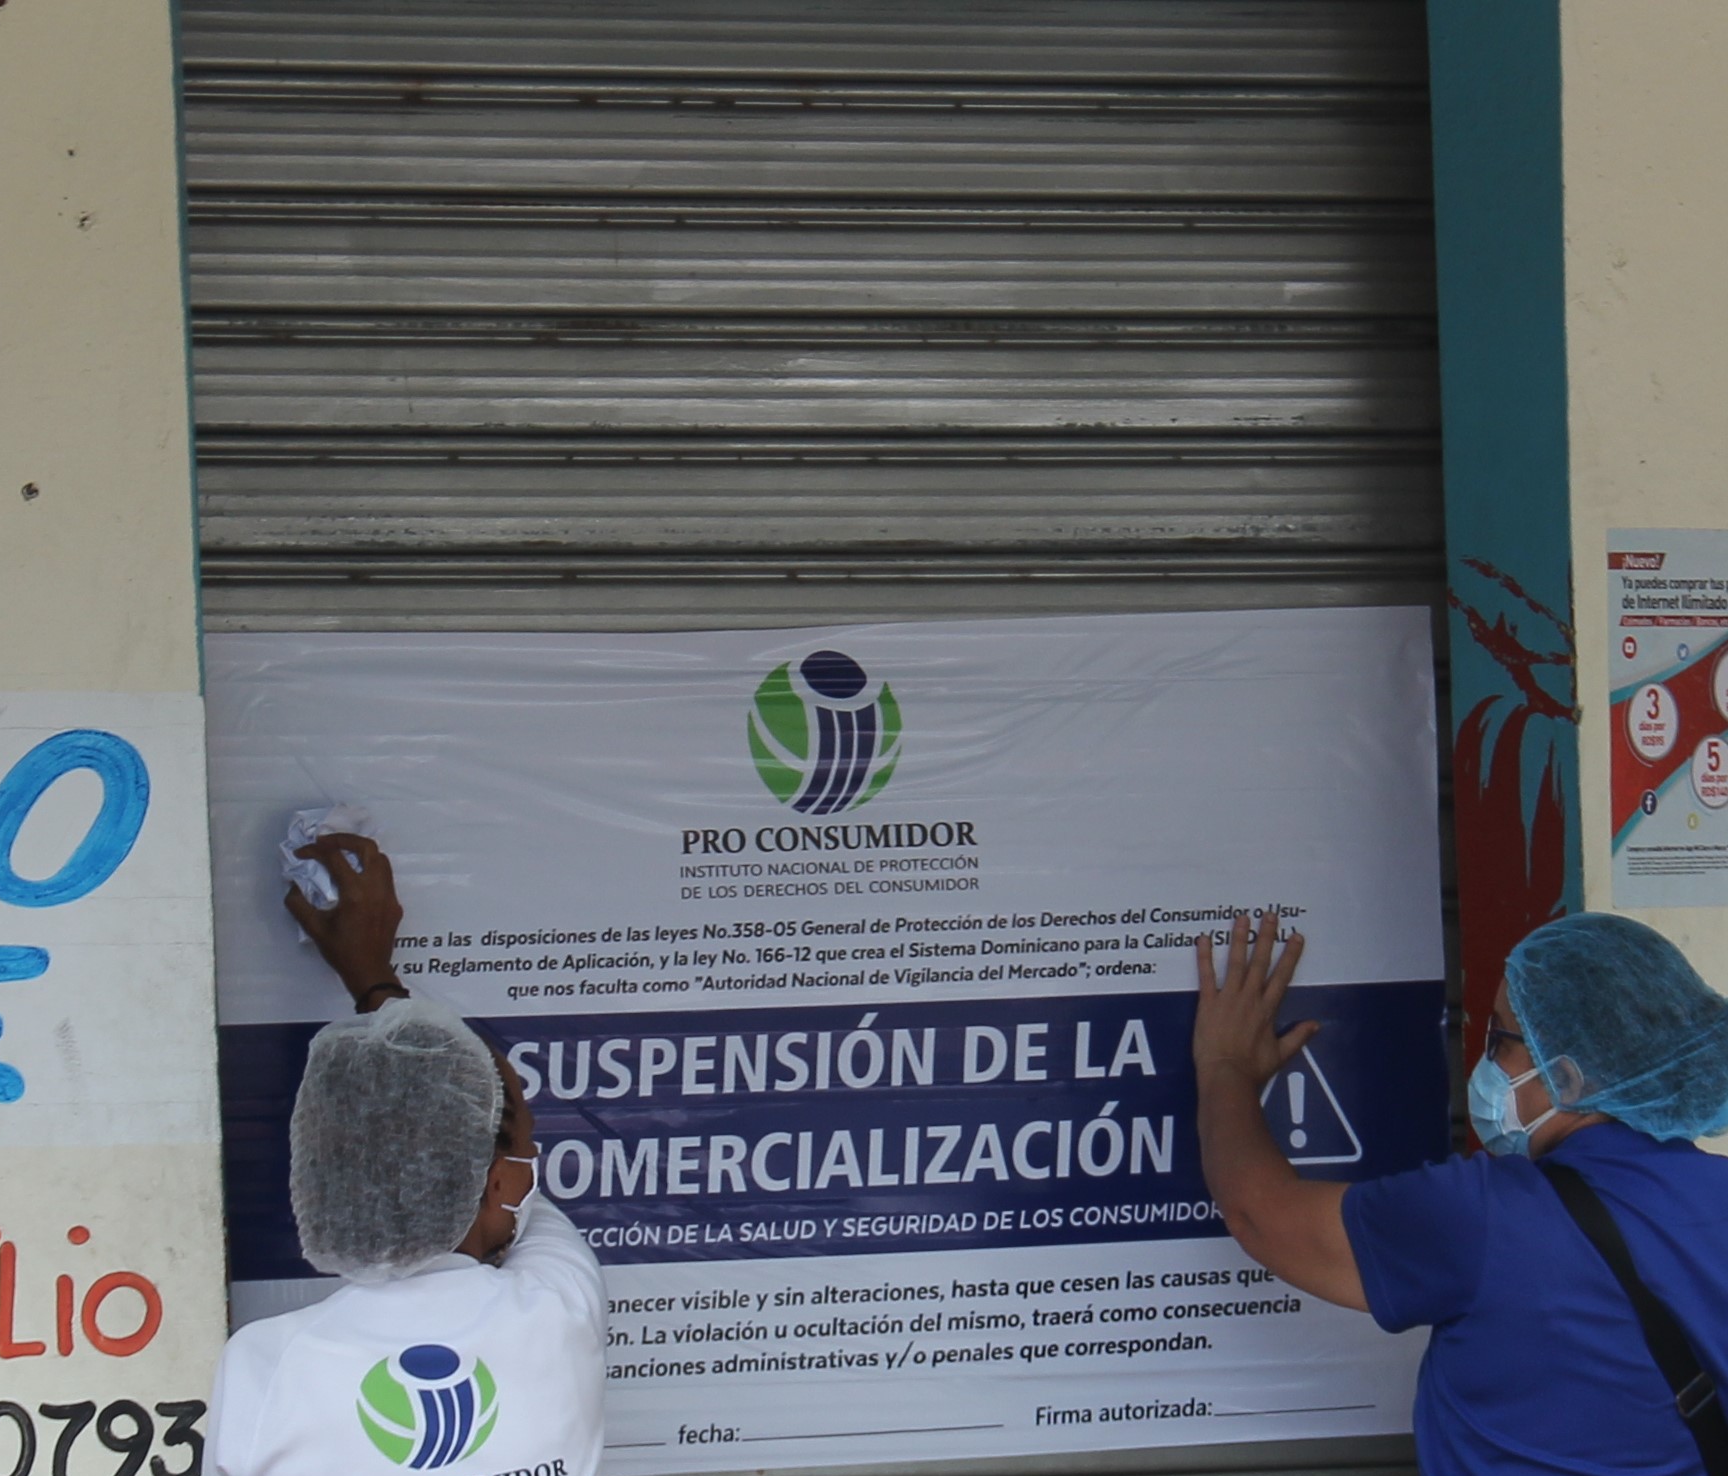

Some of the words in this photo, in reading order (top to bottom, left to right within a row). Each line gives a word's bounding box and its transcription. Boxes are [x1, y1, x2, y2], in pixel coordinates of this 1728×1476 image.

[1635, 576, 1668, 591] puedes
[1669, 578, 1708, 592] comprar
[1623, 594, 1634, 609] de
[1637, 595, 1680, 610] Internet
[1646, 688, 1660, 720] 3
[1706, 741, 1720, 772] 5
[682, 829, 746, 854] PRO
[755, 821, 978, 852] CONSUMIDOR
[680, 863, 763, 879] INSTITUTO
[768, 861, 851, 876] NACIONAL
[854, 860, 874, 873] DE
[880, 854, 979, 873] PROTECCIÓN
[681, 886, 702, 899] DE
[708, 885, 738, 898] LOS
[744, 882, 829, 898] DERECHOS
[834, 880, 863, 895] DEL
[868, 877, 980, 894] CONSUMIDOR
[432, 936, 443, 948] a
[447, 931, 472, 947] las
[480, 927, 597, 950] disposiciones
[601, 926, 623, 944] de
[626, 925, 650, 943] las
[655, 924, 699, 947] leyes
[703, 920, 798, 940] No.358-05
[801, 918, 866, 937] General
[870, 917, 891, 935] de
[894, 913, 983, 934] Protección
[987, 914, 1008, 931] de
[1012, 912, 1036, 929] los
[1040, 908, 1117, 928] Derechos
[1121, 907, 1146, 924] del
[1149, 904, 1250, 924] Consumidor
[1253, 907, 1264, 919] o
[403, 963, 423, 974] su
[428, 955, 533, 977] Reglamento
[537, 955, 558, 970] de
[562, 951, 655, 973] Aplicación,
[659, 955, 670, 970] y
[673, 951, 688, 966] la
[693, 949, 718, 969] ley
[722, 948, 751, 965] No.
[755, 946, 811, 964] 166-12
[816, 947, 847, 967] que
[851, 946, 885, 961] crea
[890, 943, 905, 958] el
[909, 941, 976, 958] Sistema
[981, 937, 1080, 956] Dominicano
[1084, 937, 1120, 955] para
[1124, 933, 1139, 949] la
[506, 983, 539, 1001] que
[543, 981, 574, 997] nos
[578, 978, 639, 996] faculta
[642, 979, 690, 993] como
[791, 971, 865, 989] Nacional
[869, 970, 890, 985] de
[893, 967, 974, 988] Vigilancia
[978, 966, 1004, 981] del
[1095, 960, 1157, 977] ordena:
[506, 1013, 936, 1101] SUSPENSIÓN
[963, 1022, 1049, 1085] DE
[1074, 1018, 1157, 1081] LA
[533, 1100, 1175, 1199] OMERCIALIZACIÓN
[666, 1224, 699, 1245] DE
[704, 1223, 734, 1243] LA
[739, 1218, 817, 1243] SALUD
[823, 1217, 838, 1238] Y
[842, 1212, 977, 1237] SEGURIDAD
[982, 1210, 1014, 1231] DE
[1019, 1208, 1064, 1230] LOS
[681, 1288, 750, 1311] visible
[755, 1291, 769, 1313] y
[773, 1286, 805, 1307] sin
[810, 1282, 944, 1306] alteraciones,
[951, 1279, 1010, 1299] hasta
[1015, 1280, 1055, 1300] que
[1060, 1276, 1120, 1293] cesen
[1125, 1270, 1155, 1290] las
[1160, 1268, 1231, 1288] causas
[1236, 1267, 1275, 1289] que
[641, 1325, 667, 1345] La
[673, 1320, 768, 1344] violación
[774, 1324, 787, 1339] u
[793, 1315, 903, 1339] ocultación
[909, 1313, 941, 1332] del
[947, 1310, 1026, 1332] mismo,
[1032, 1303, 1094, 1327] traerá
[1099, 1306, 1157, 1323] como
[1162, 1293, 1302, 1320] consecuencia
[711, 1349, 880, 1374] administrativas
[885, 1341, 927, 1369] y/o
[932, 1342, 1014, 1368] penales
[1019, 1344, 1059, 1363] que
[1064, 1332, 1213, 1358] correspondan.
[1034, 1403, 1093, 1427] Firma
[1098, 1397, 1214, 1424] autorizada:
[676, 1422, 742, 1446] fecha:
